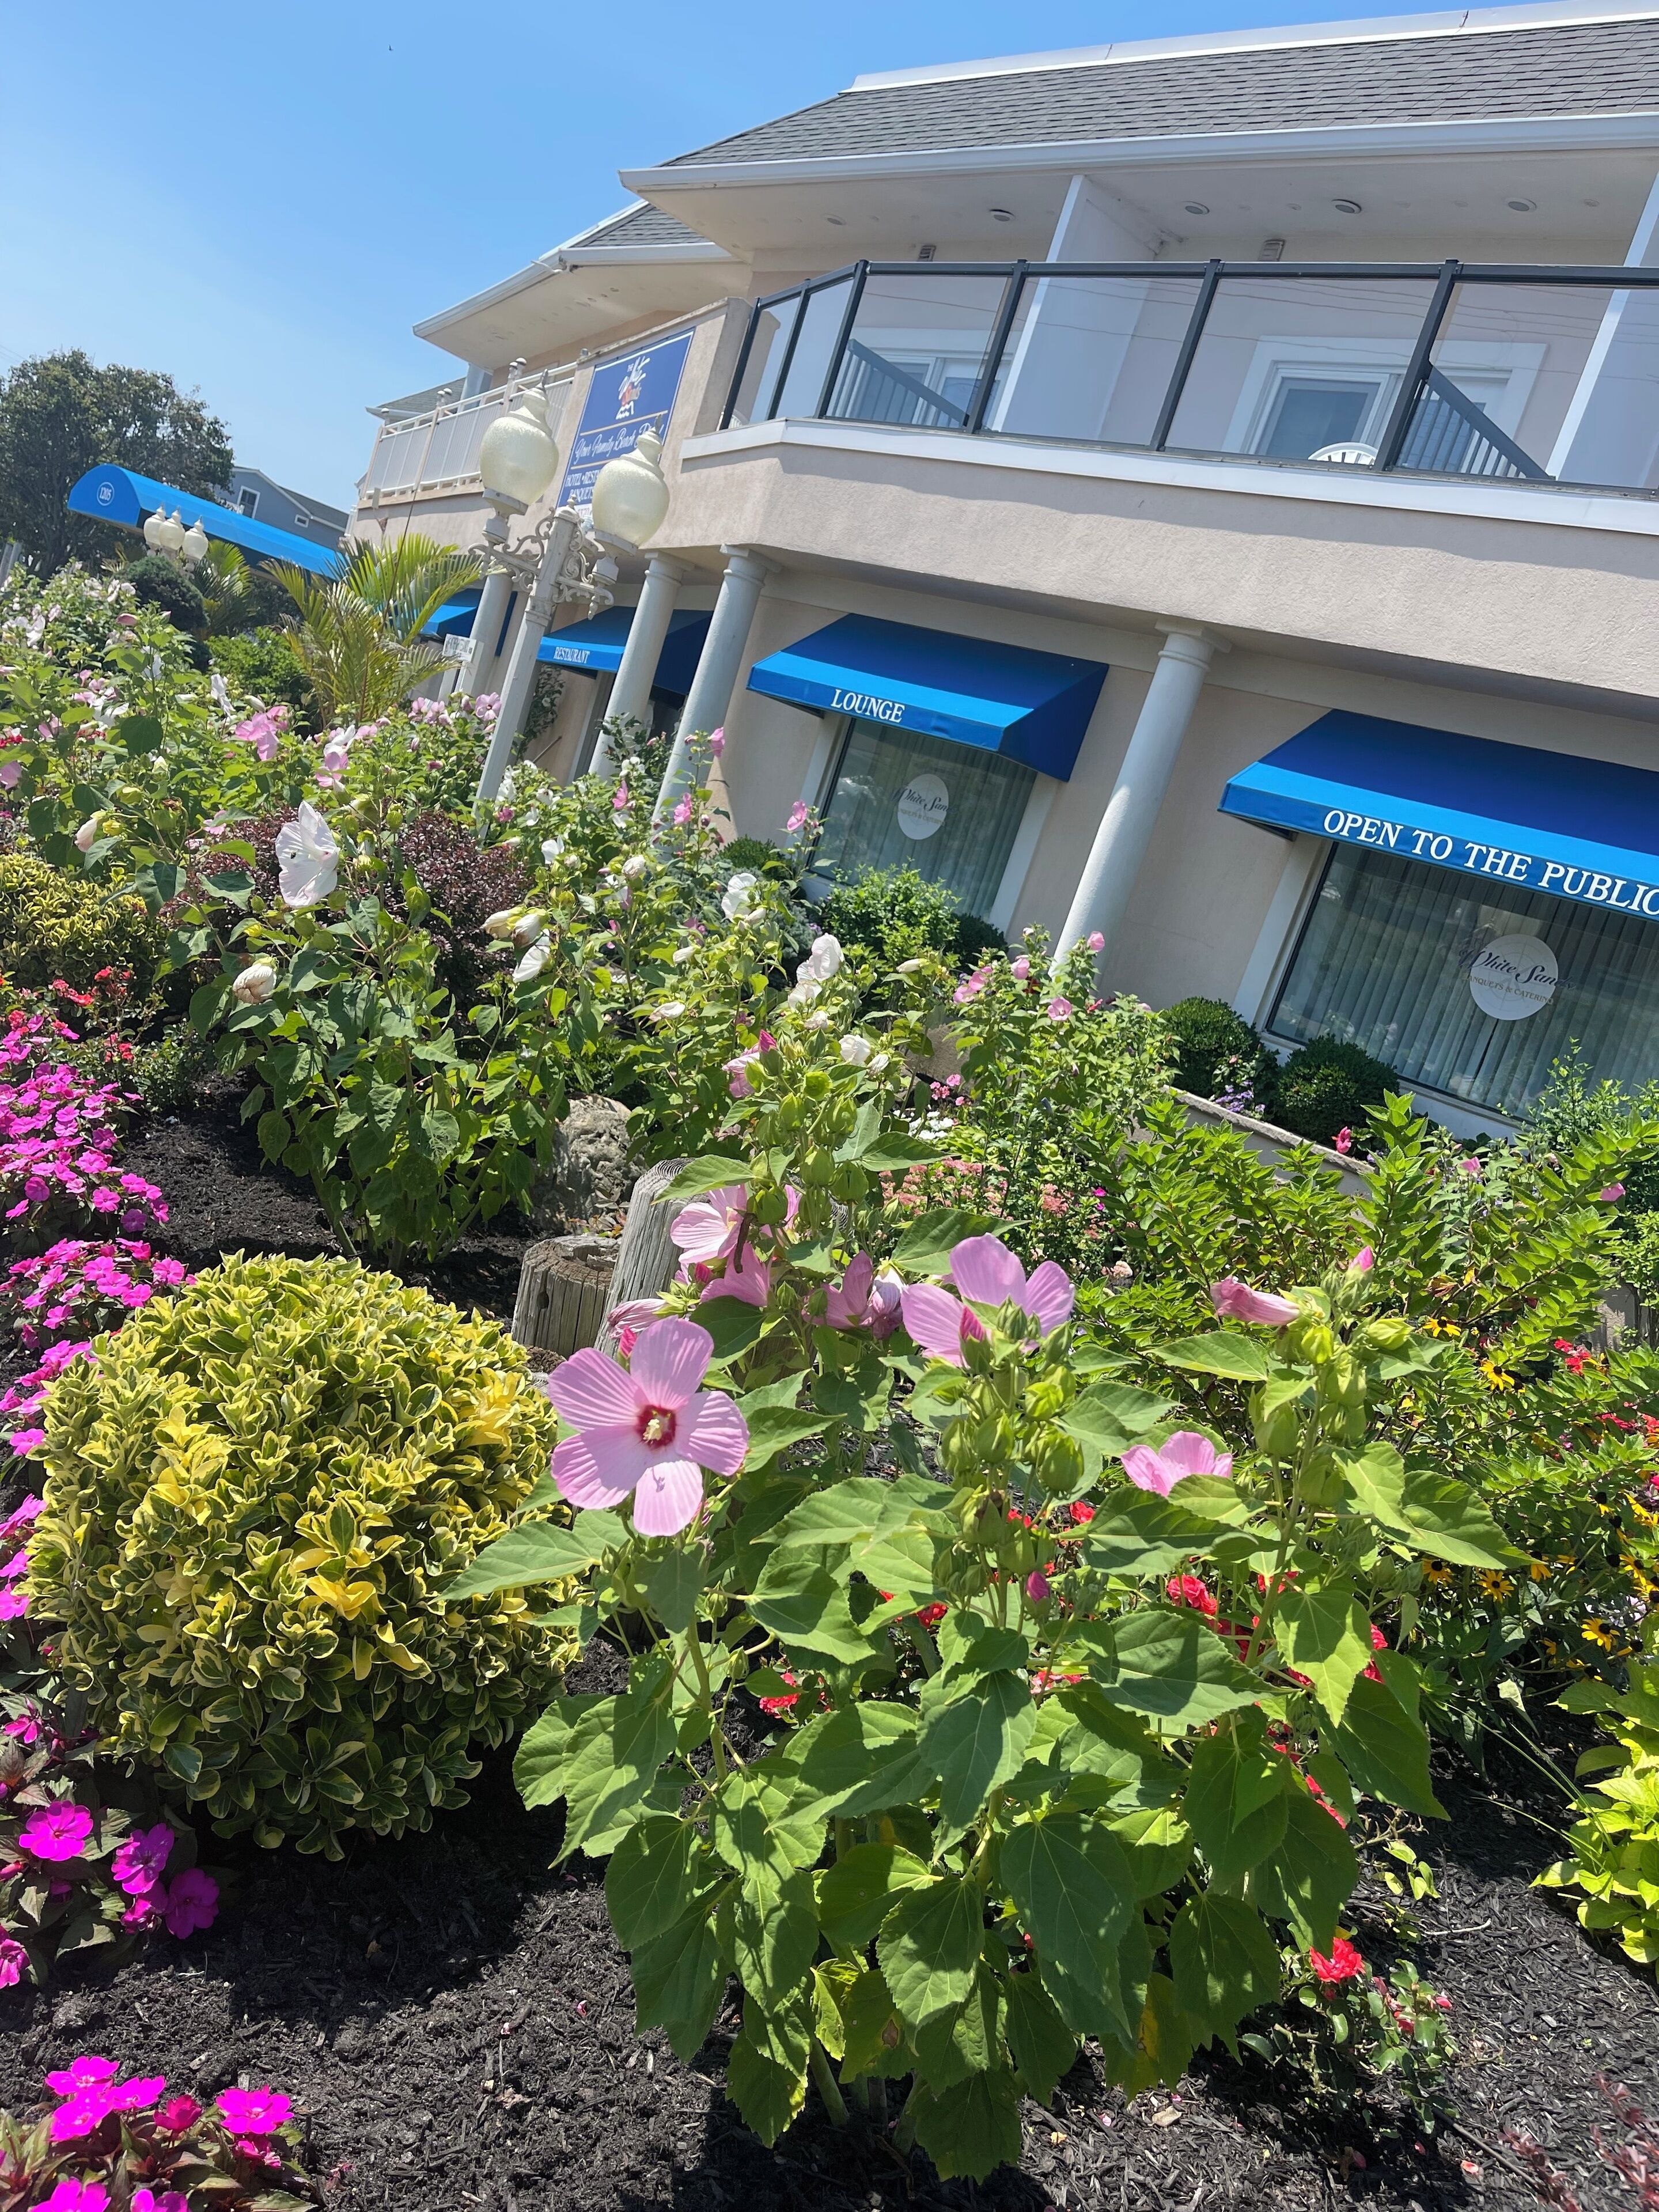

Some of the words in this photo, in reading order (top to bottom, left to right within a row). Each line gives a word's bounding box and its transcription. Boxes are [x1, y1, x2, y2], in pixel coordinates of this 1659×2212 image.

[592, 434, 614, 457] Family
[565, 473, 582, 487] HOTEL
[553, 646, 590, 664] RESTAURANT
[831, 689, 906, 723] LOUNGE
[1324, 810, 1404, 848] OPEN
[1412, 830, 1453, 859] TO
[1464, 842, 1532, 881] THE
[1537, 862, 1659, 915] PUBLIC
[1459, 949, 1517, 974] White
[1514, 988, 1554, 1005] CATERING
